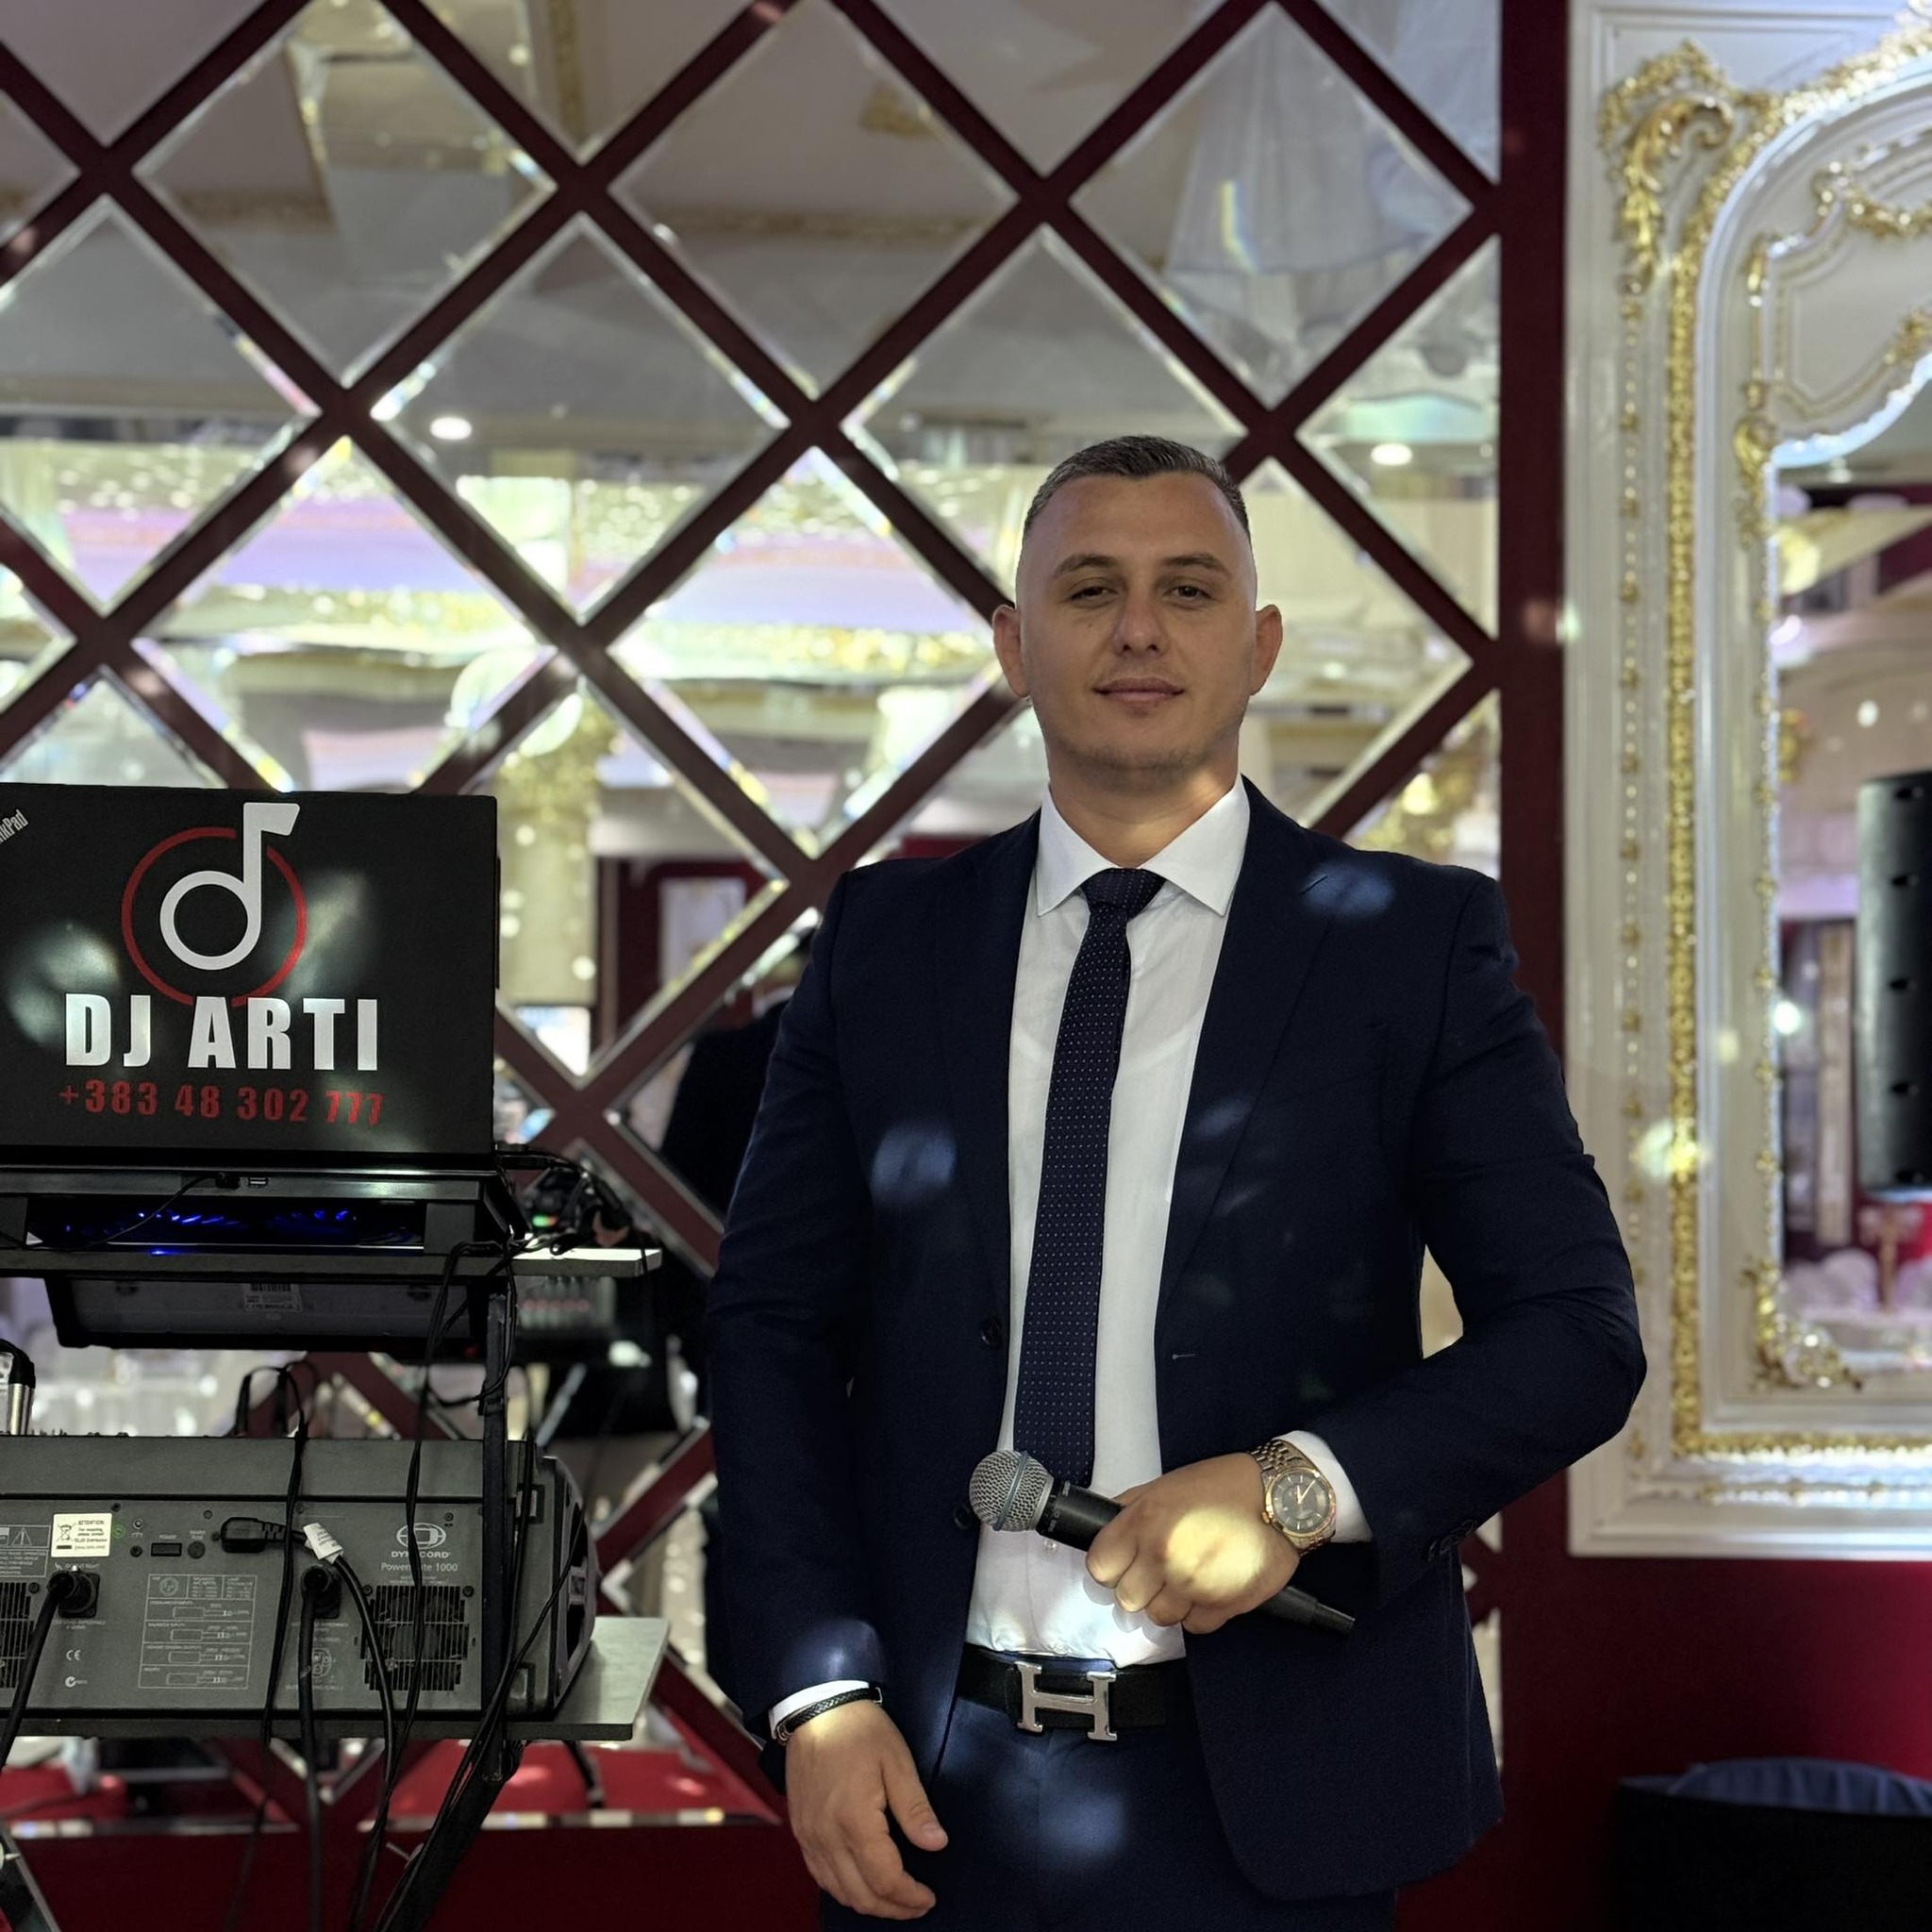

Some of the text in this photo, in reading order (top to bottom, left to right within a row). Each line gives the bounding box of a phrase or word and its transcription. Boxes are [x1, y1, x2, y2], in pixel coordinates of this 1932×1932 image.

[0, 808, 28, 844] nkPad
[65, 992, 378, 1071] DJ ARTI
[58, 1079, 384, 1127] +383 48 302 777
[391, 1550, 449, 1559] DYCORD
[436, 1562, 458, 1573] 1000
